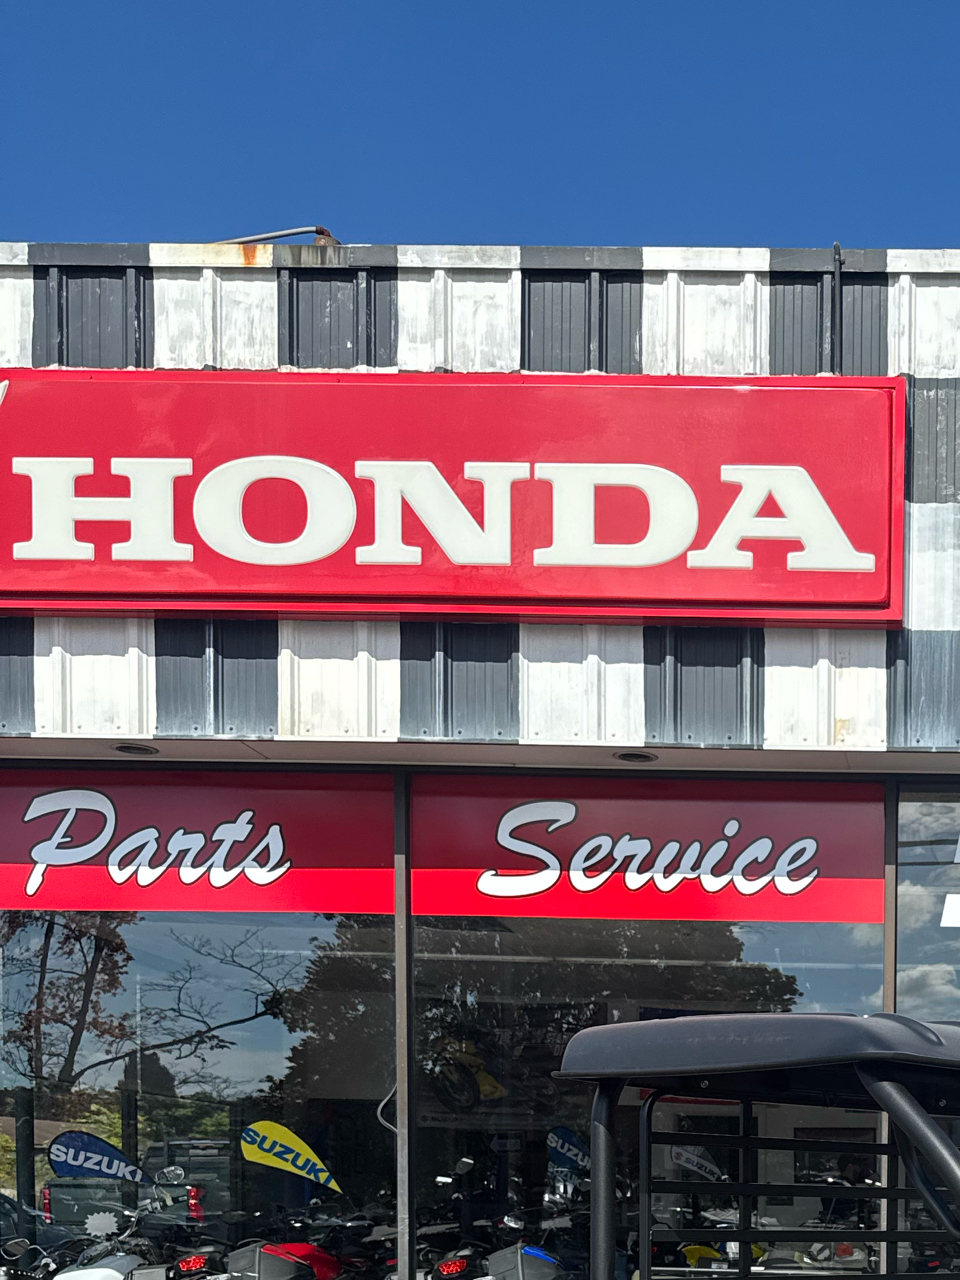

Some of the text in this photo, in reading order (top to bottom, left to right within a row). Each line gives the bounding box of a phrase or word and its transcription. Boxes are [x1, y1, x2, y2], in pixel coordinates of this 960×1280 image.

[12, 455, 876, 573] HONDA
[24, 788, 292, 897] Parts
[475, 800, 819, 898] Service
[50, 1144, 143, 1183] SUZUKI
[241, 1127, 334, 1186] SUZUKI
[683, 1156, 718, 1178] SUZUK
